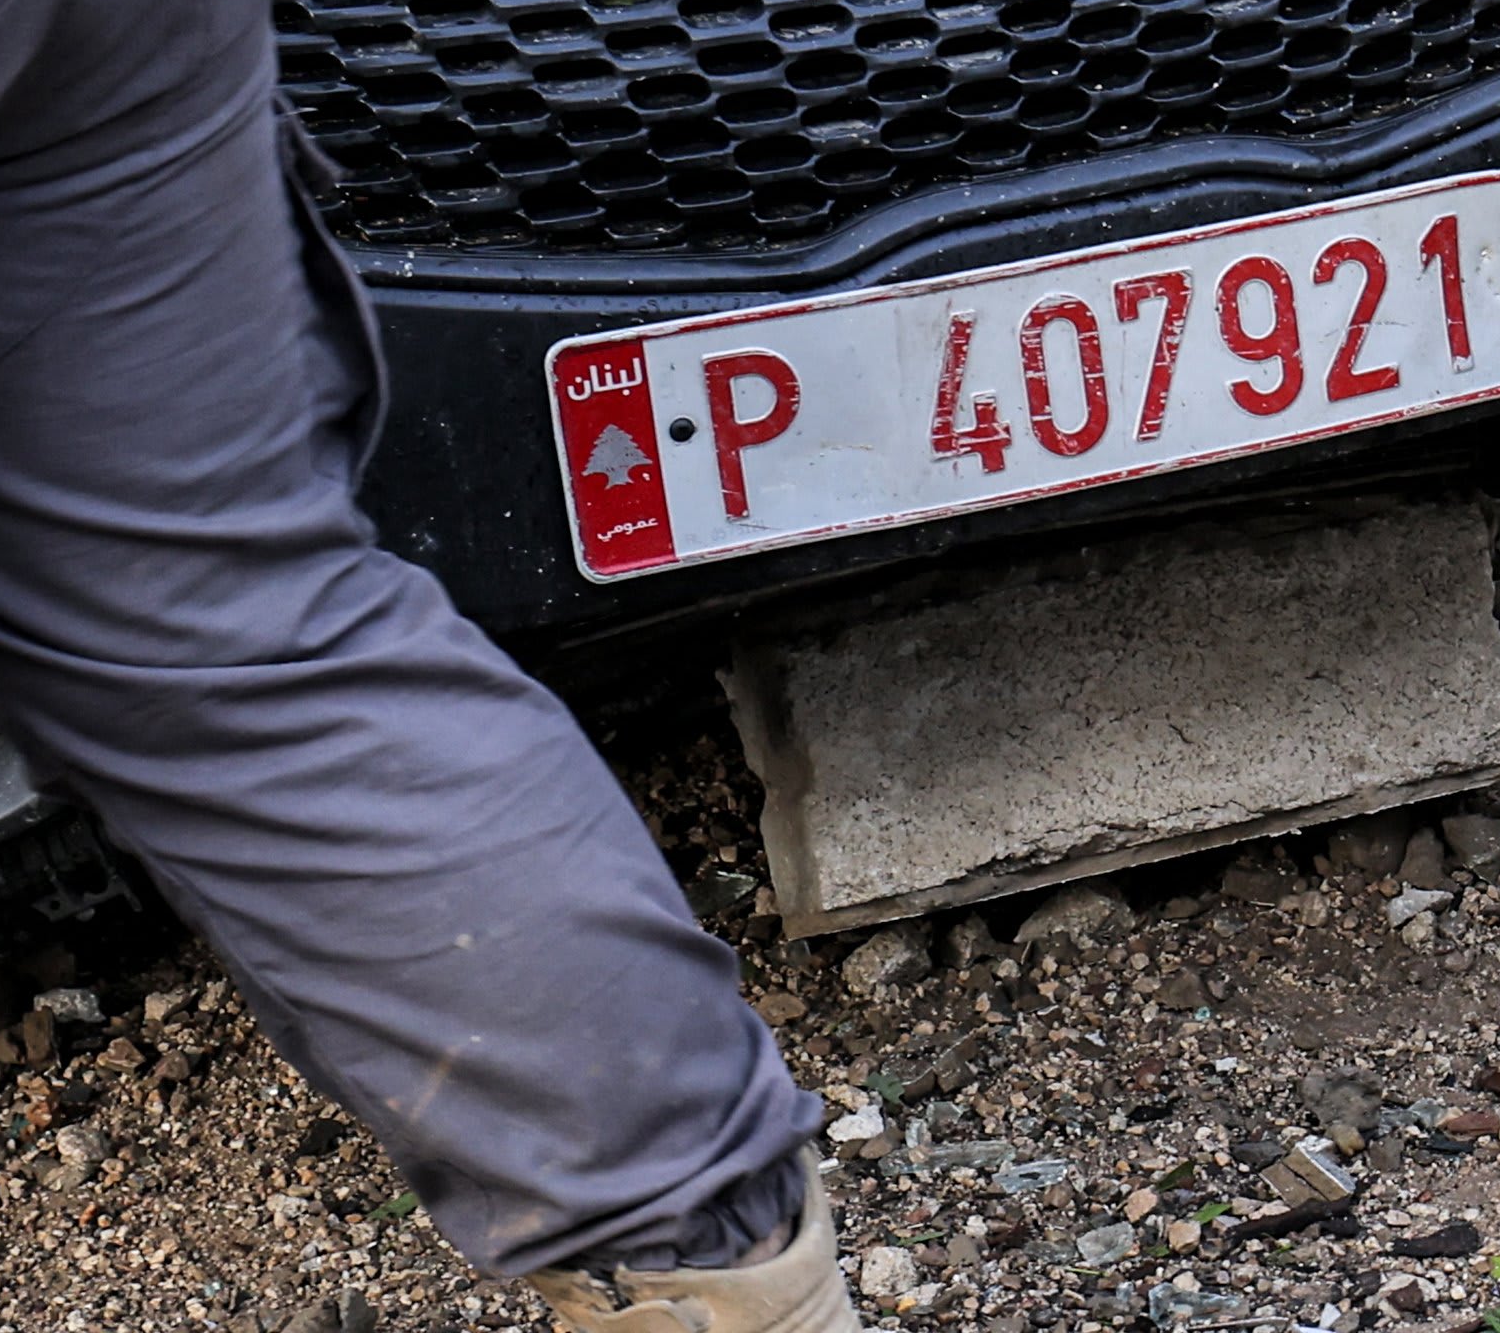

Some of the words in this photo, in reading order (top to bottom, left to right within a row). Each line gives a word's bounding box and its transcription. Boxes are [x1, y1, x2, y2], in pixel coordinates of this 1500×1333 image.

[566, 357, 644, 402] لبنان
[702, 348, 802, 522] P
[928, 212, 1477, 475] 407921
[596, 517, 660, 543] عمومي
